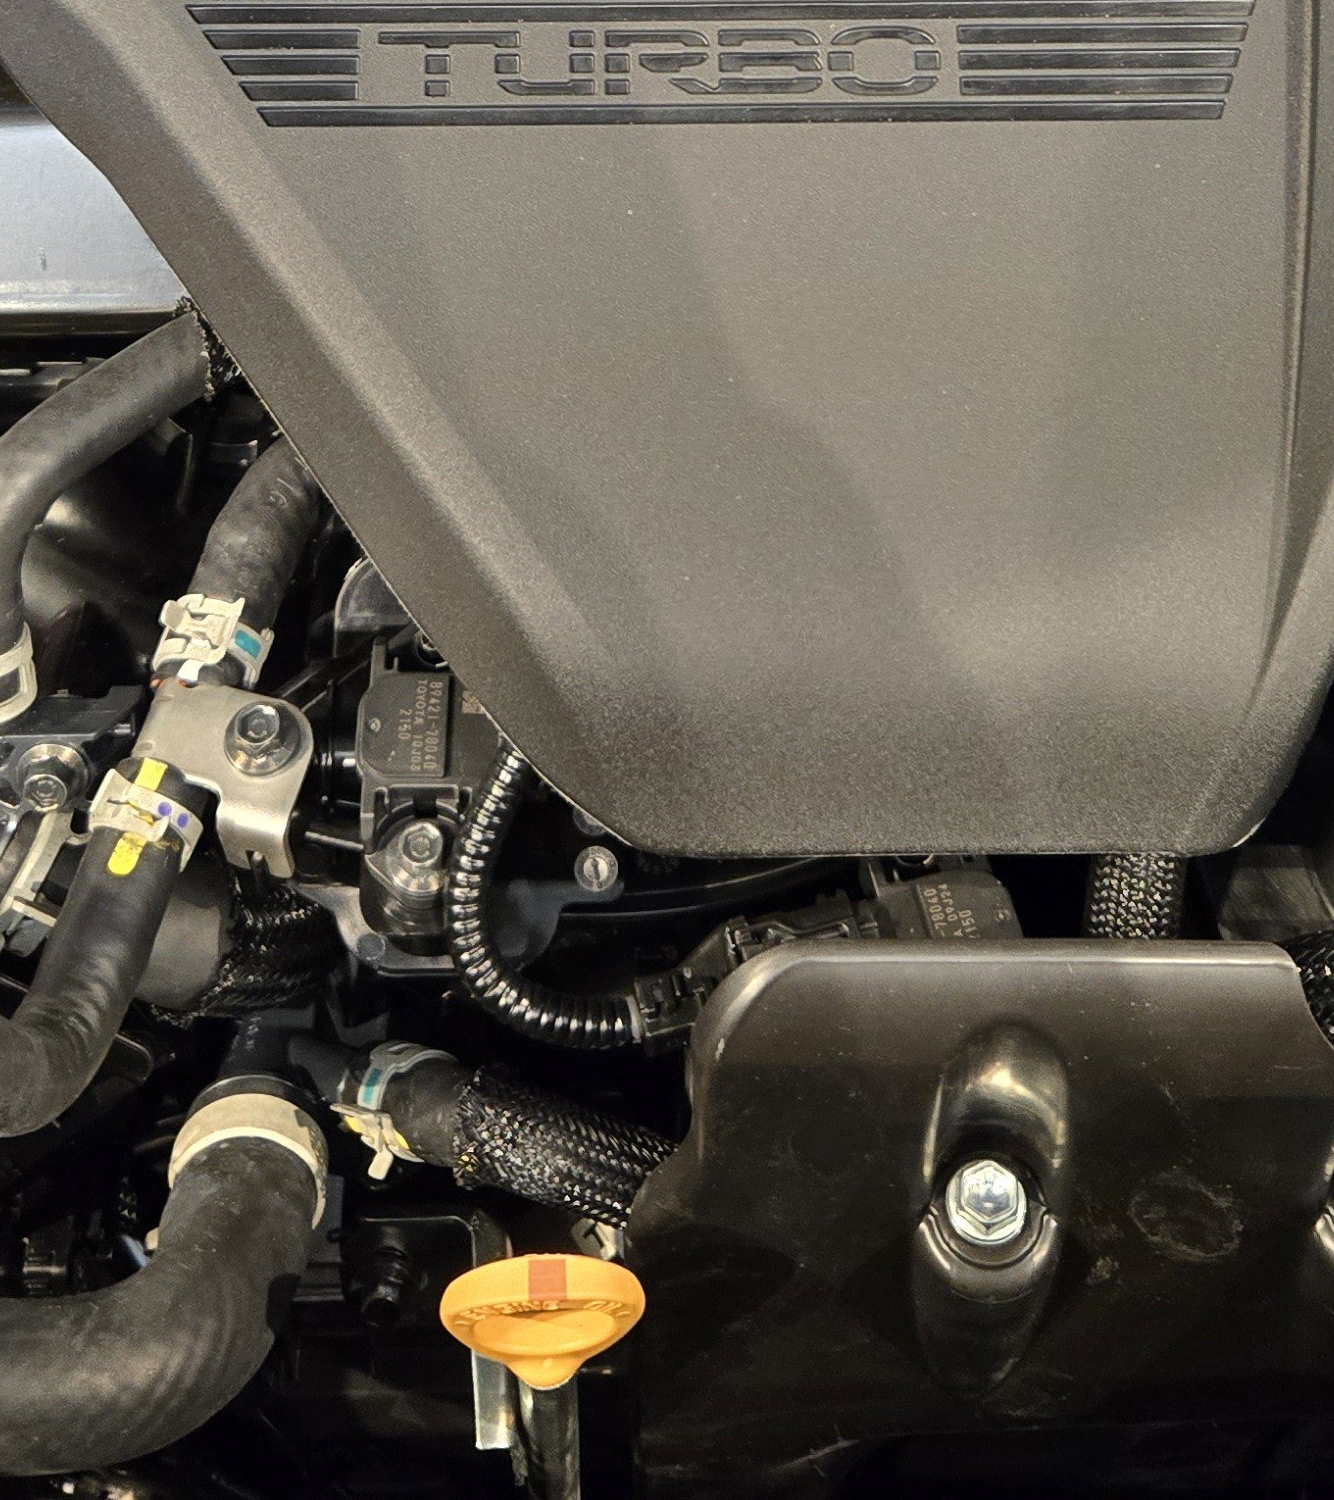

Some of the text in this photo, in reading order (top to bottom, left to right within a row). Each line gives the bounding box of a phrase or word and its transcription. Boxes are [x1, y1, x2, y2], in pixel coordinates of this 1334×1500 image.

[378, 26, 941, 97] TURBO
[415, 680, 427, 724] TOYOTA
[398, 709, 412, 740] 2150
